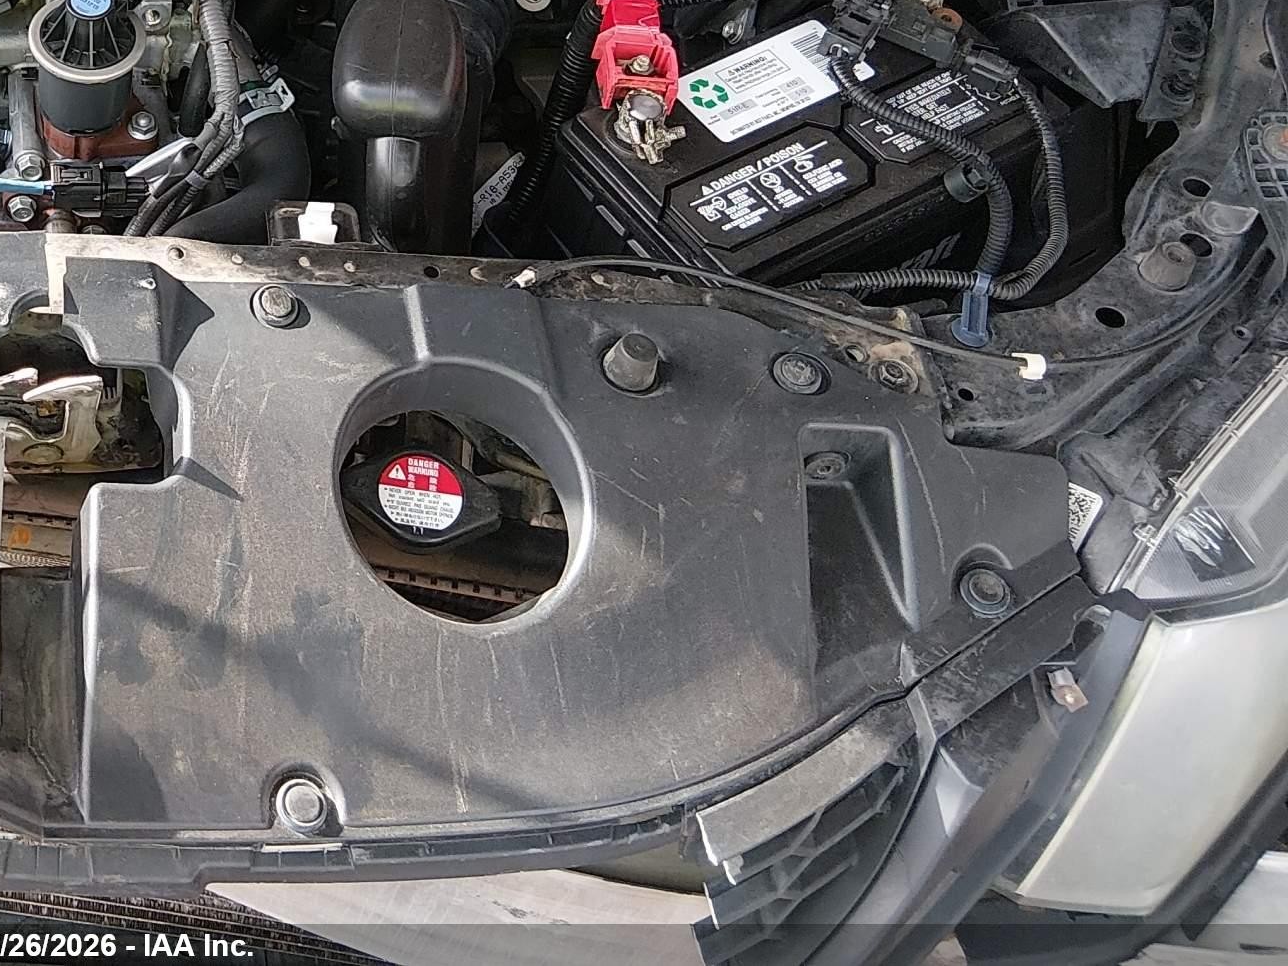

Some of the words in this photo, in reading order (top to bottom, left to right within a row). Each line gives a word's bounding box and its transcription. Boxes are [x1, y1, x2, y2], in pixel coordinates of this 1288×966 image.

[916, 87, 952, 106] IMMEDIATELY
[708, 164, 757, 191] DANGER
[762, 141, 805, 166] POISON
[407, 457, 440, 469] DANGER
